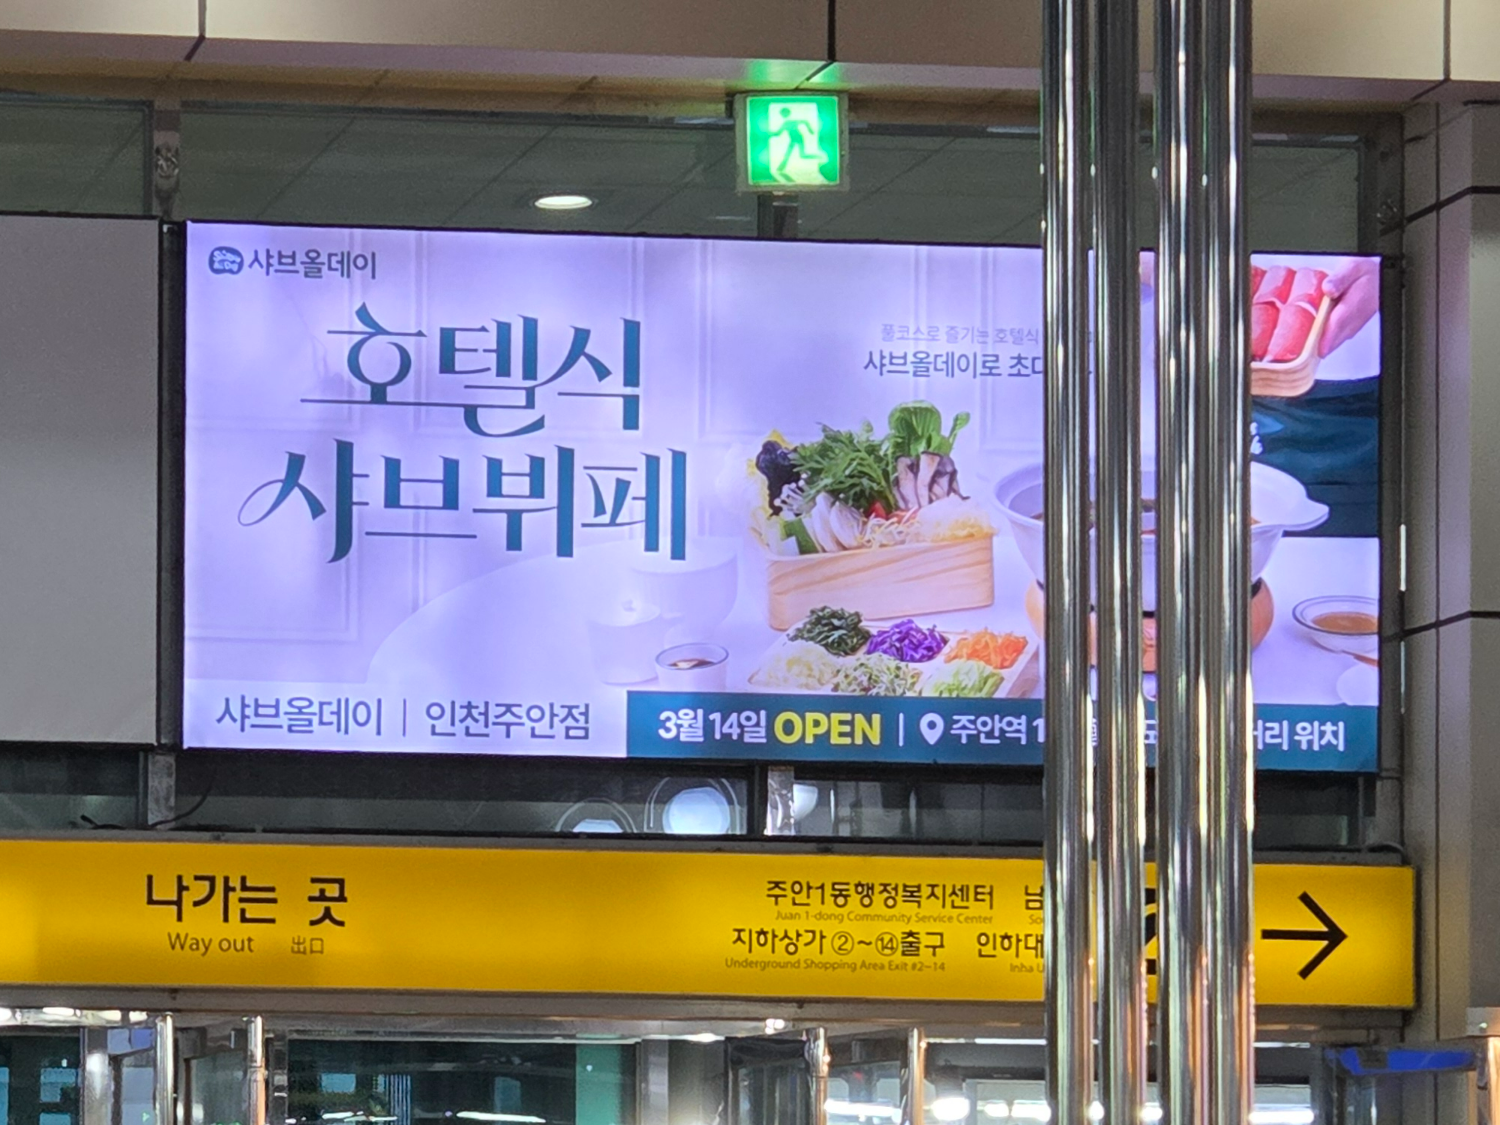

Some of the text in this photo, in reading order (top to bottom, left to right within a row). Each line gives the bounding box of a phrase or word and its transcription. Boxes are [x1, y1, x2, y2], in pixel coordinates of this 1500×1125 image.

[248, 248, 376, 280] 샤브올데이
[881, 323, 941, 342] 풀코스로
[946, 325, 989, 344] 즐기는
[300, 301, 641, 438] 호텔식
[863, 349, 1002, 379] 샤브올데이로
[237, 438, 686, 564] 샤브뷔페
[216, 694, 590, 740] 샤브올데이 인천주안점
[658, 708, 880, 745] 3월 14일 OPEN
[950, 713, 1027, 745] 주안역
[1294, 720, 1345, 752] 위치
[146, 874, 348, 927] 나가는 곳
[766, 880, 994, 910] 주안1동행정복지센터
[775, 911, 993, 925] Juan 1-dong Community Service Center
[167, 932, 255, 957] Way out
[290, 935, 325, 955] 出口
[977, 932, 1044, 958] 인하대
[725, 957, 801, 971] Underground
[803, 959, 857, 973] Shopping
[860, 960, 886, 970] Area
[888, 960, 908, 971] Exit
